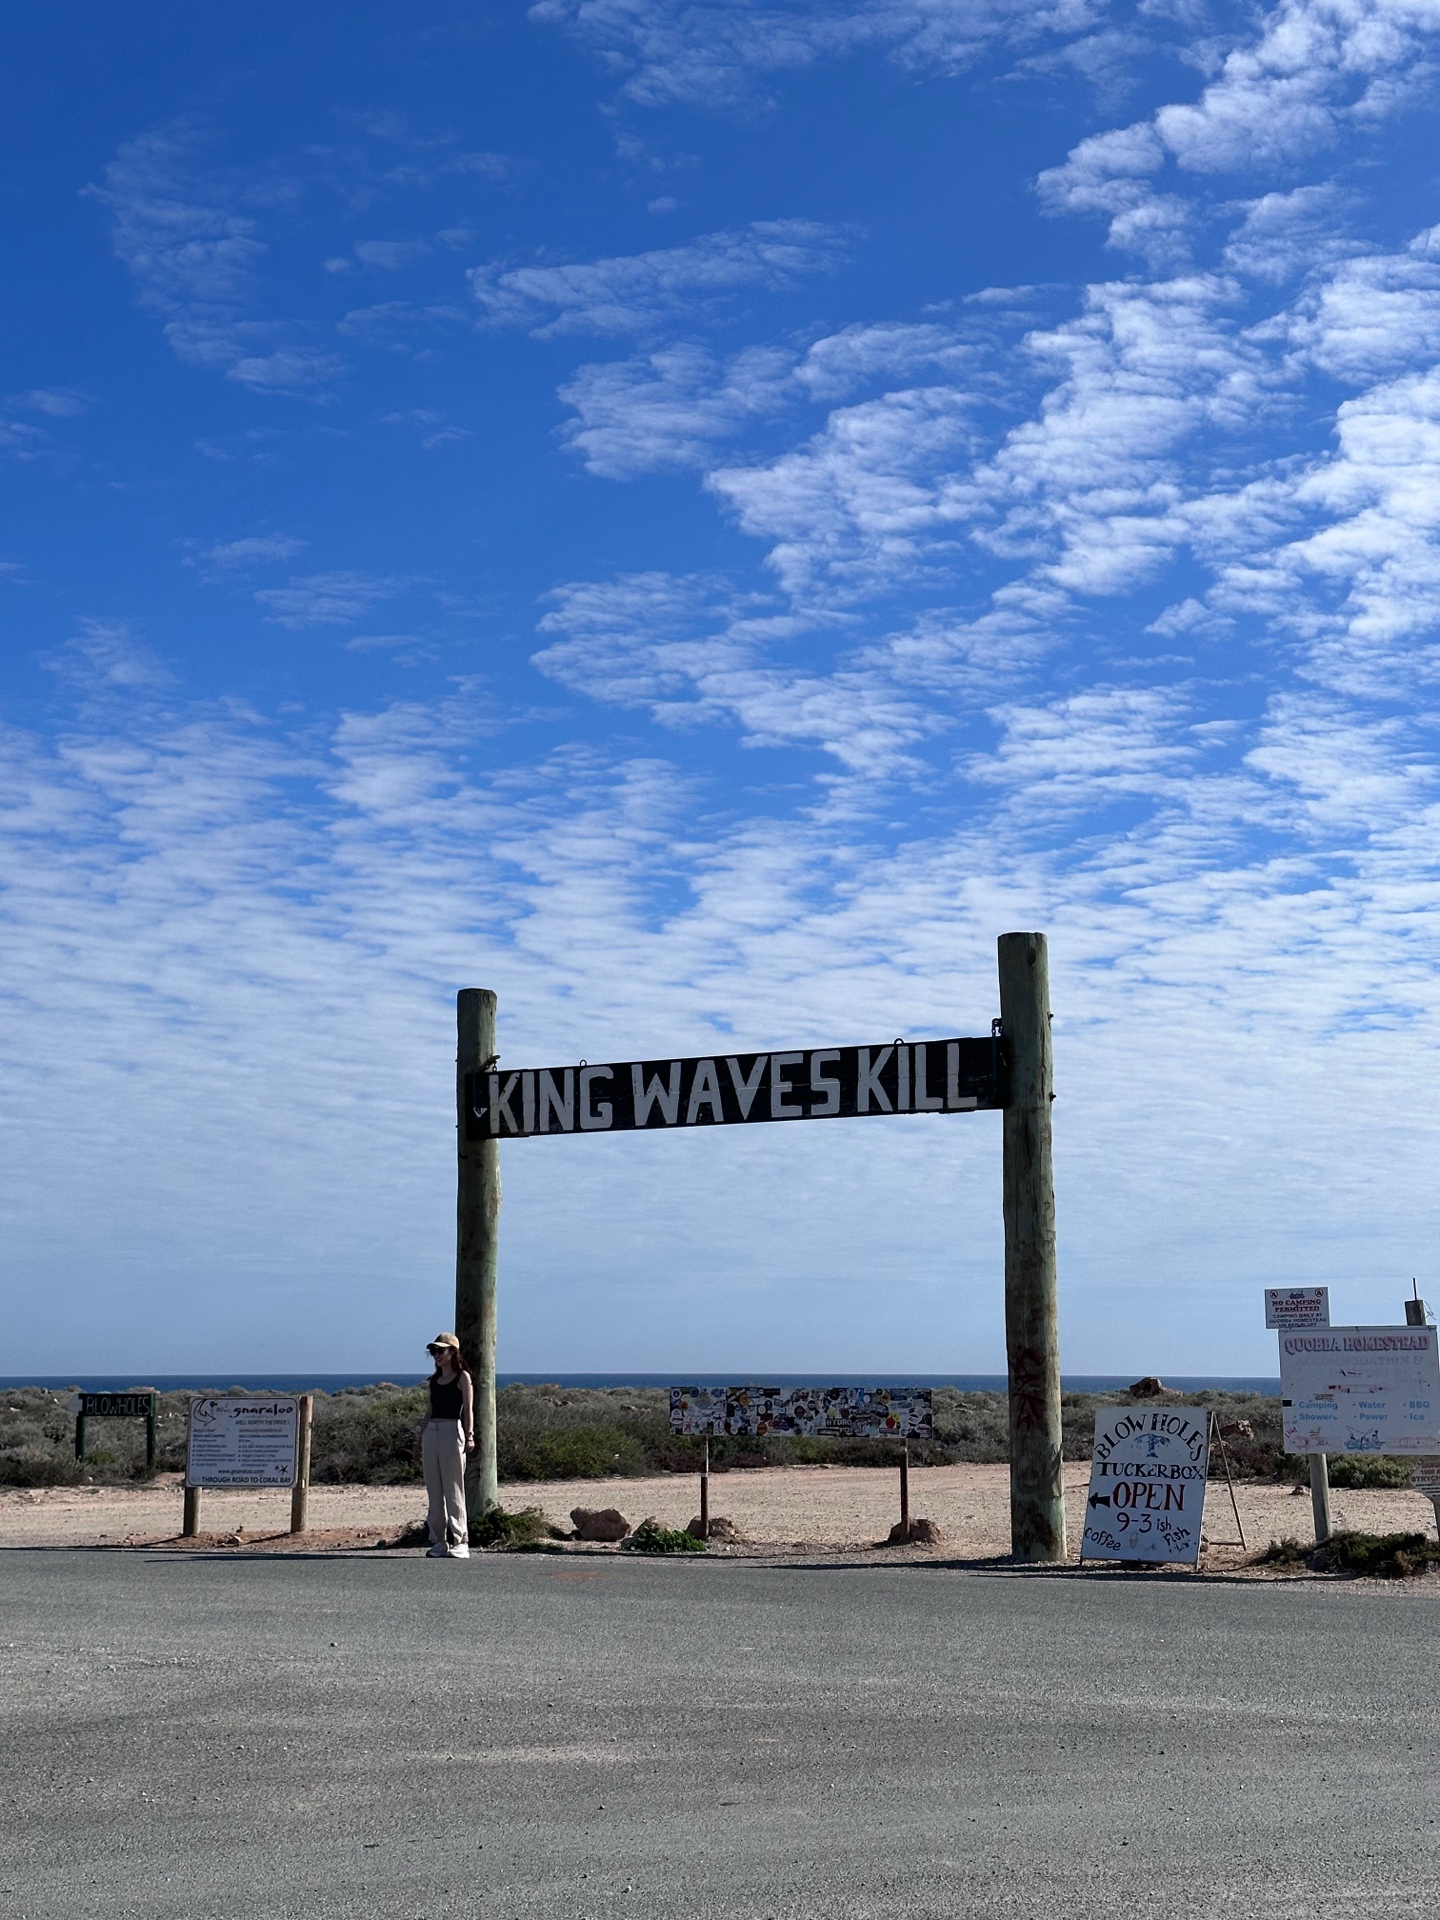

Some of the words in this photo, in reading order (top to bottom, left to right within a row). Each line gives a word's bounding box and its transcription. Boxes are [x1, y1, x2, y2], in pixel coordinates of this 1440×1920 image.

[489, 1066, 614, 1134] KING
[632, 1050, 841, 1126] WAVES
[857, 1043, 977, 1111] KILL
[1285, 1338, 1342, 1354] QUOBBA
[1344, 1335, 1430, 1352] HOMESTEAD
[86, 1396, 150, 1416] BLOWHOLES
[229, 1404, 293, 1418] gnaraloo
[1299, 1402, 1338, 1410] Camping
[1358, 1401, 1386, 1409] Water
[1410, 1401, 1430, 1410] BBQ
[1096, 1462, 1205, 1480] TUCKERBOX
[1112, 1482, 1186, 1510] OPEN
[1116, 1512, 1151, 1533] 9-3
[1157, 1516, 1172, 1532] ish
[1085, 1528, 1121, 1550] coffee
